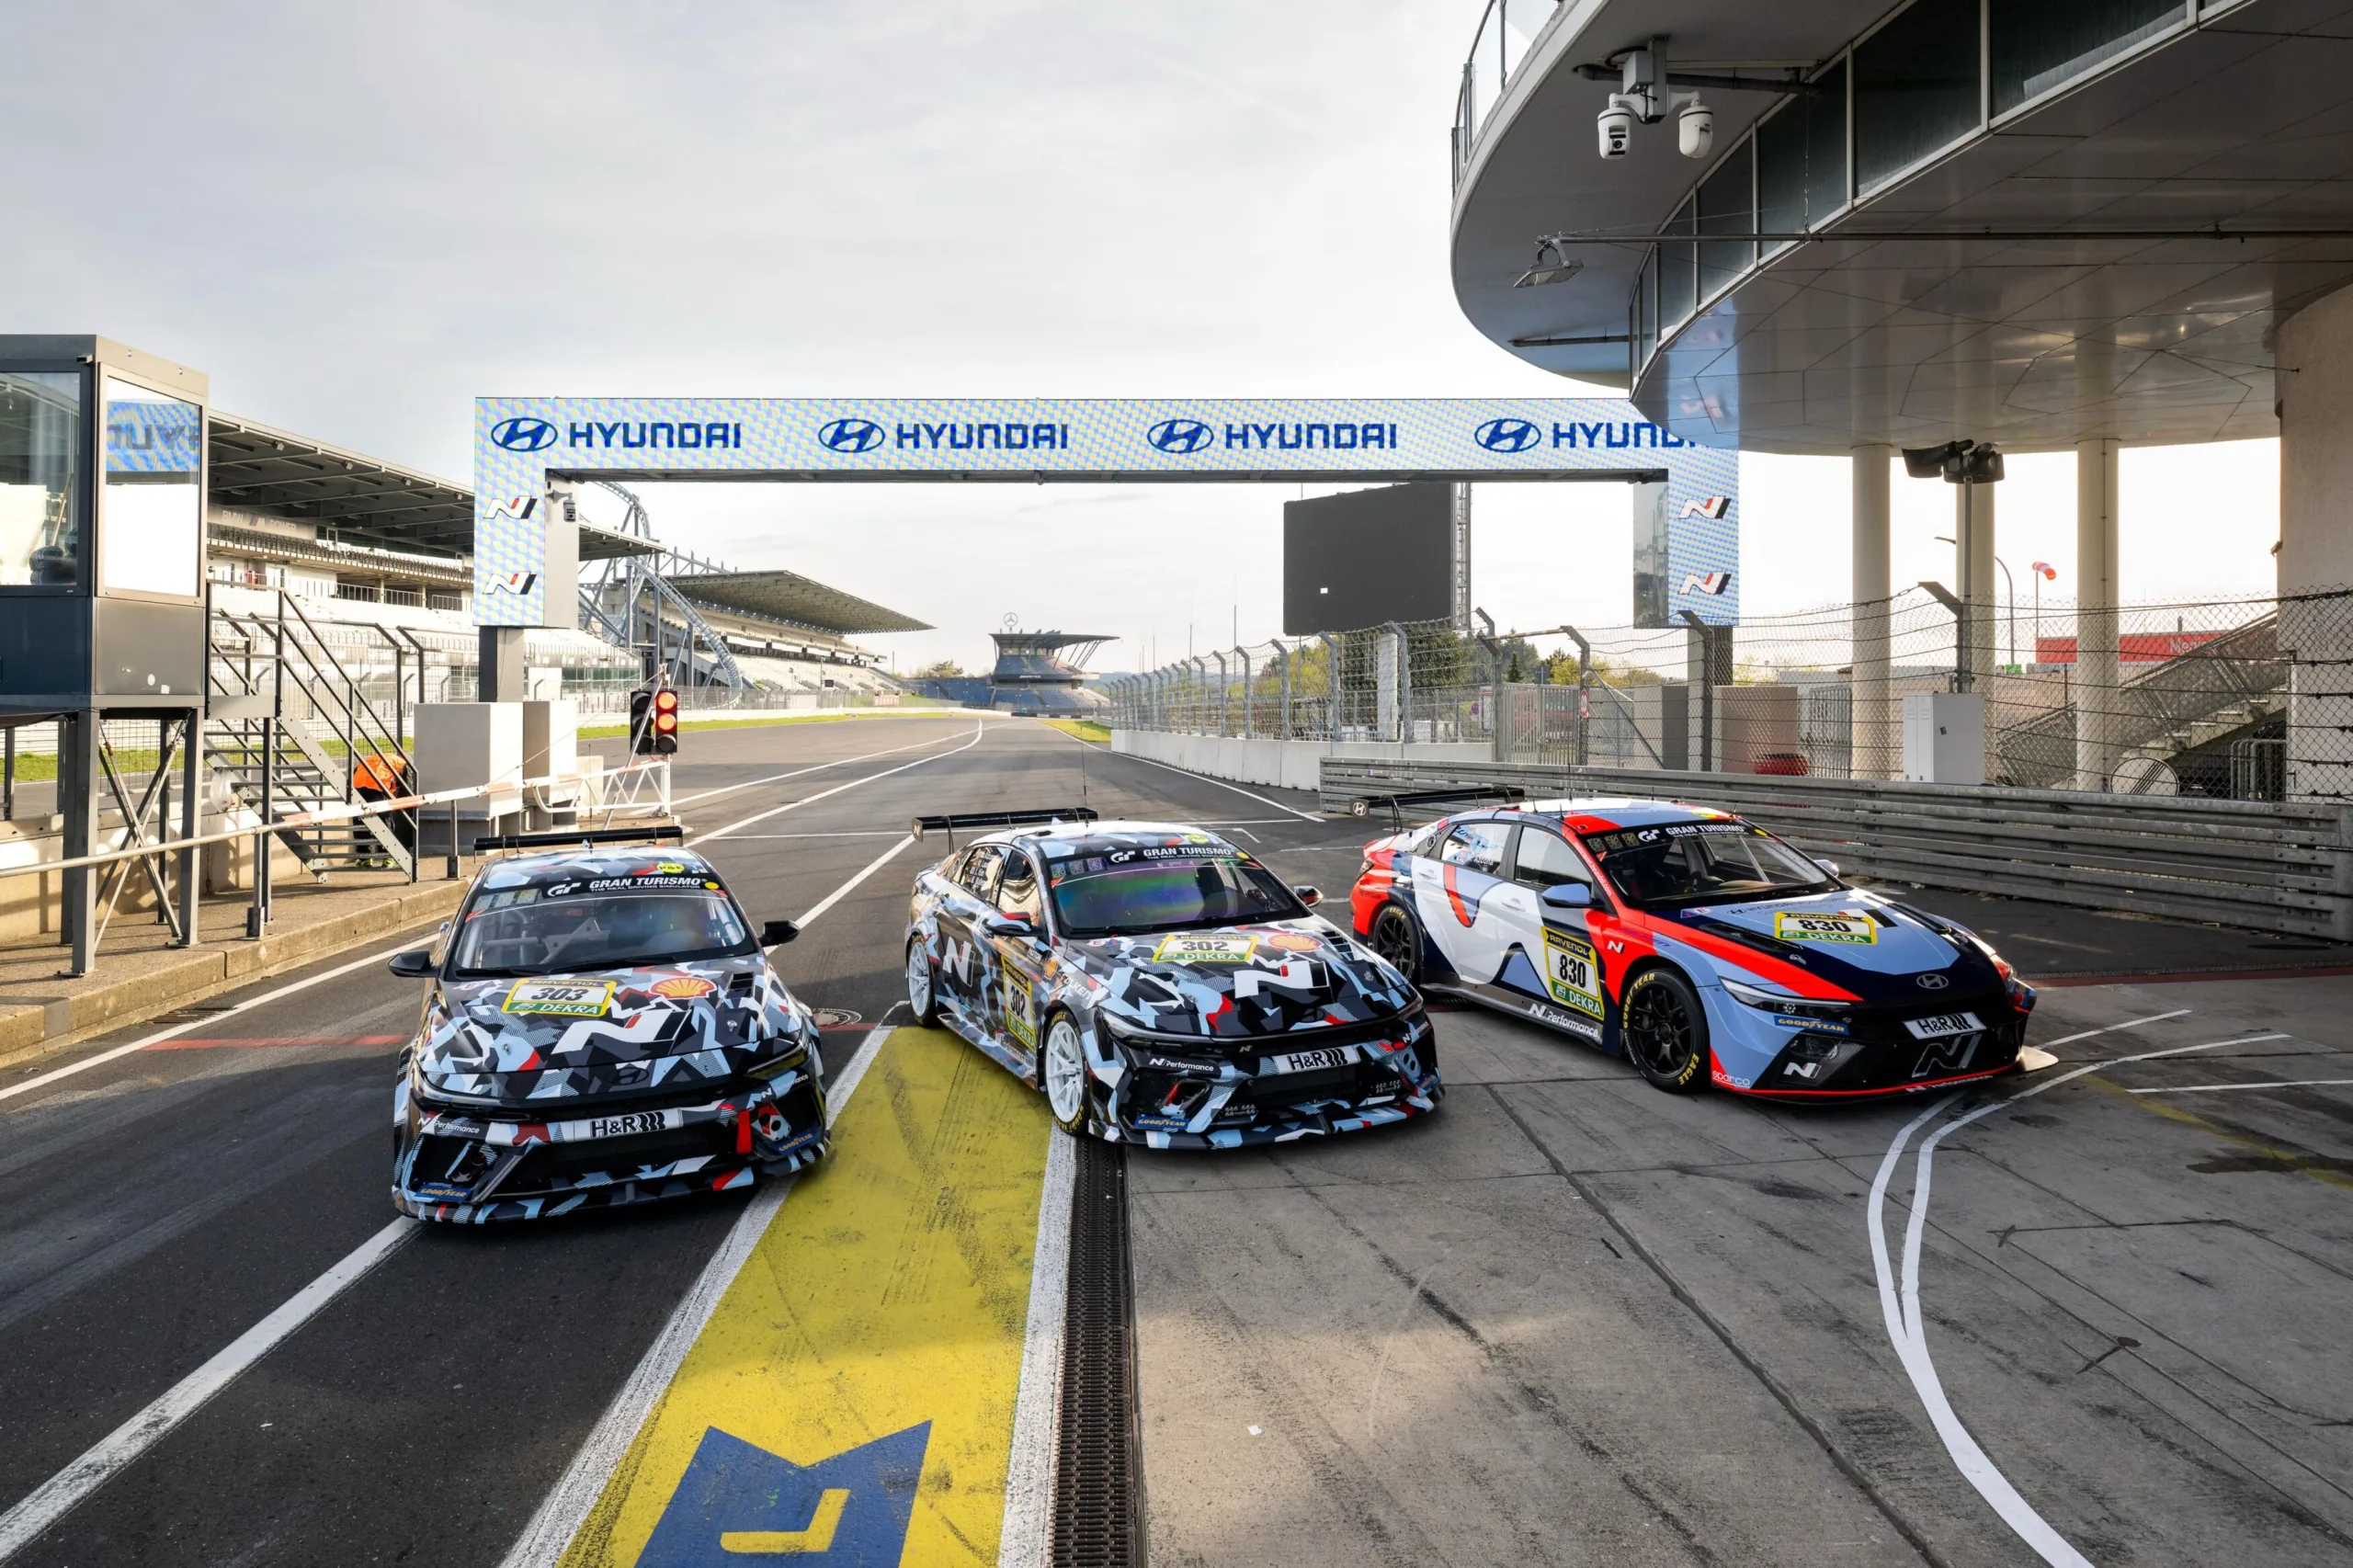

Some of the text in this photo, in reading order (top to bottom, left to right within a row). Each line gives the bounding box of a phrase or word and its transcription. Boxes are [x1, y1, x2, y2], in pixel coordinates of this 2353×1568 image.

[570, 422, 741, 449] HYUNDAI
[897, 423, 1068, 449] HYUNDAI
[1225, 423, 1397, 449] HYUNDAI
[1665, 825, 1745, 835] GRAN TURISMO
[1143, 846, 1232, 857] GRAN TURISMO
[589, 877, 700, 889] GRAN TURISMO
[1389, 907, 1406, 920] EAGLE
[1798, 919, 1852, 932] 830
[1808, 933, 1866, 943] DEKRA
[1182, 941, 1229, 951] 302
[1550, 935, 1588, 956] RAVENOL
[1608, 940, 1624, 954] N
[1559, 954, 1586, 989] 830
[531, 987, 588, 1001] 303
[540, 1004, 598, 1015] DEKRA
[1010, 985, 1026, 1020] 302
[1569, 990, 1602, 1017] DEKRA
[1547, 1011, 1599, 1038] Performance
[1778, 1017, 1846, 1032] GOODYEAR
[1149, 1058, 1214, 1072] N Performance
[1678, 1052, 1699, 1085] EAGLE
[1711, 1070, 1751, 1088] sparco
[435, 1121, 480, 1134] Performance
[591, 1114, 640, 1138] H&R
[1138, 1119, 1186, 1128] GOODYEAR
[420, 1188, 467, 1198] GOODYEAR
